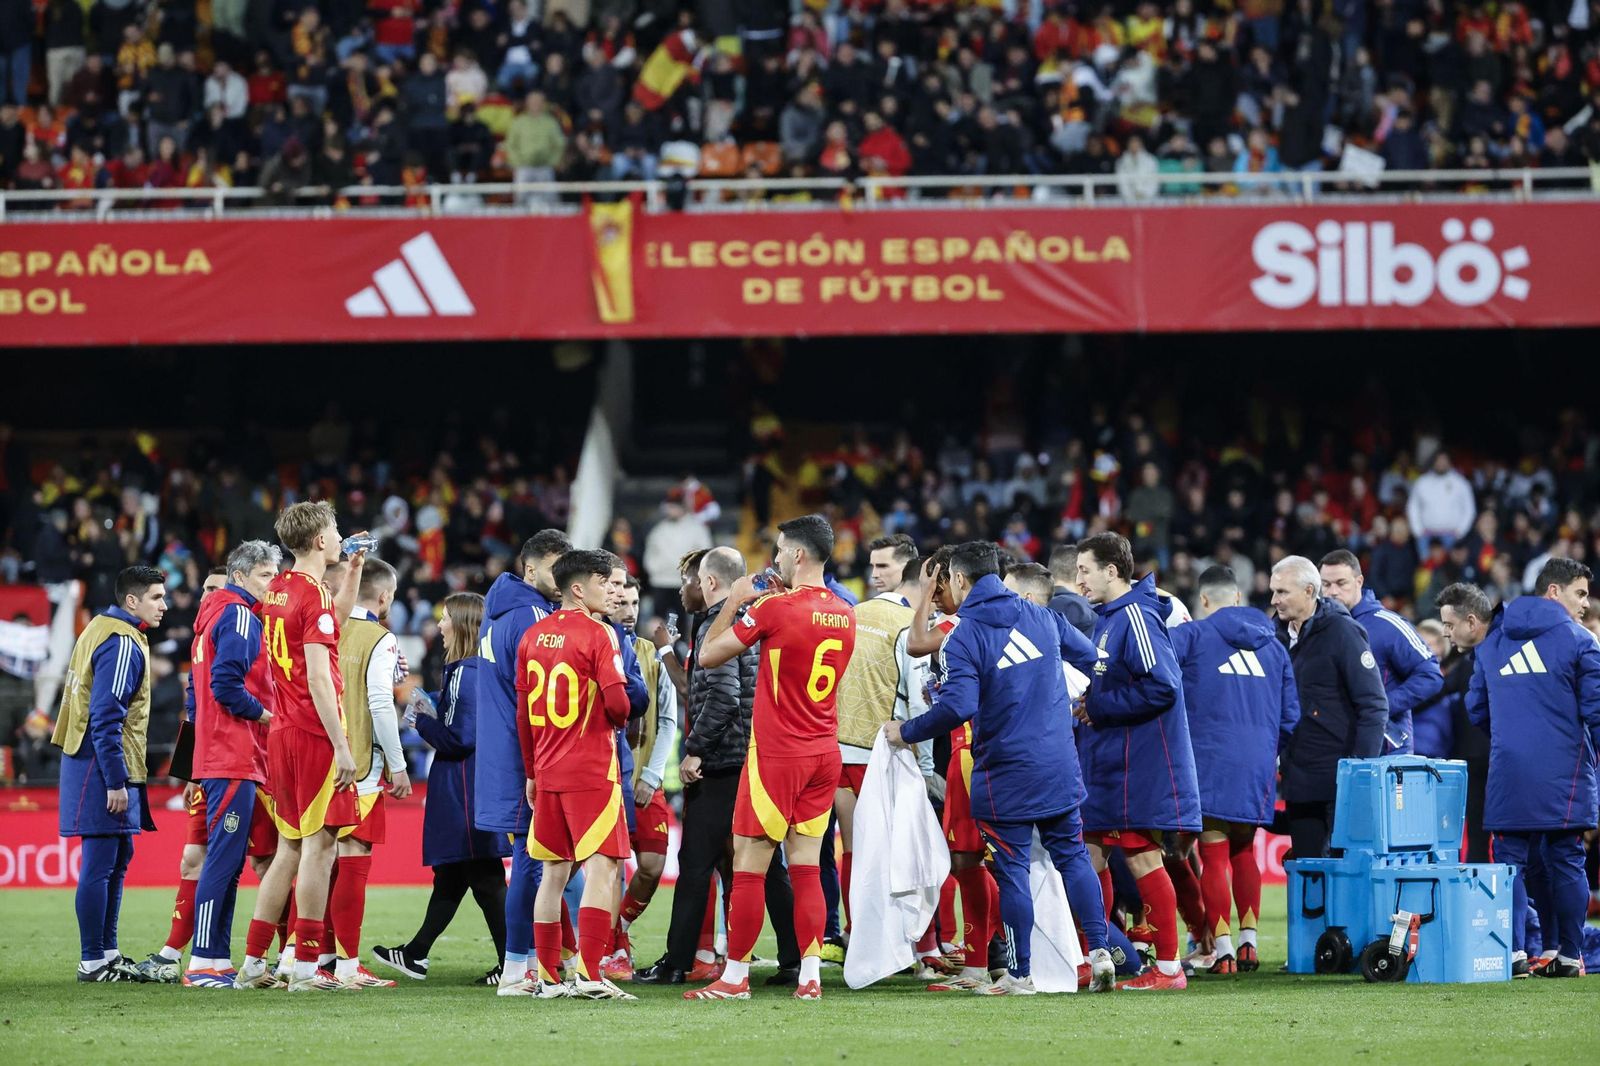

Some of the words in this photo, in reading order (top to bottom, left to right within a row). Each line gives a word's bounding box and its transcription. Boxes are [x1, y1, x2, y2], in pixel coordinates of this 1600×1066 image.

[0, 243, 212, 277] SPAÑOLA
[880, 230, 1131, 265] ESPAÑOLA
[1250, 217, 1502, 309] Silbö
[0, 287, 87, 315] BOL
[742, 277, 803, 304] DE
[820, 268, 1004, 304] FÚTBOL
[812, 611, 849, 629] MERINO
[536, 632, 566, 649] PEDRI
[806, 638, 843, 703] 6
[526, 658, 580, 729] 20
